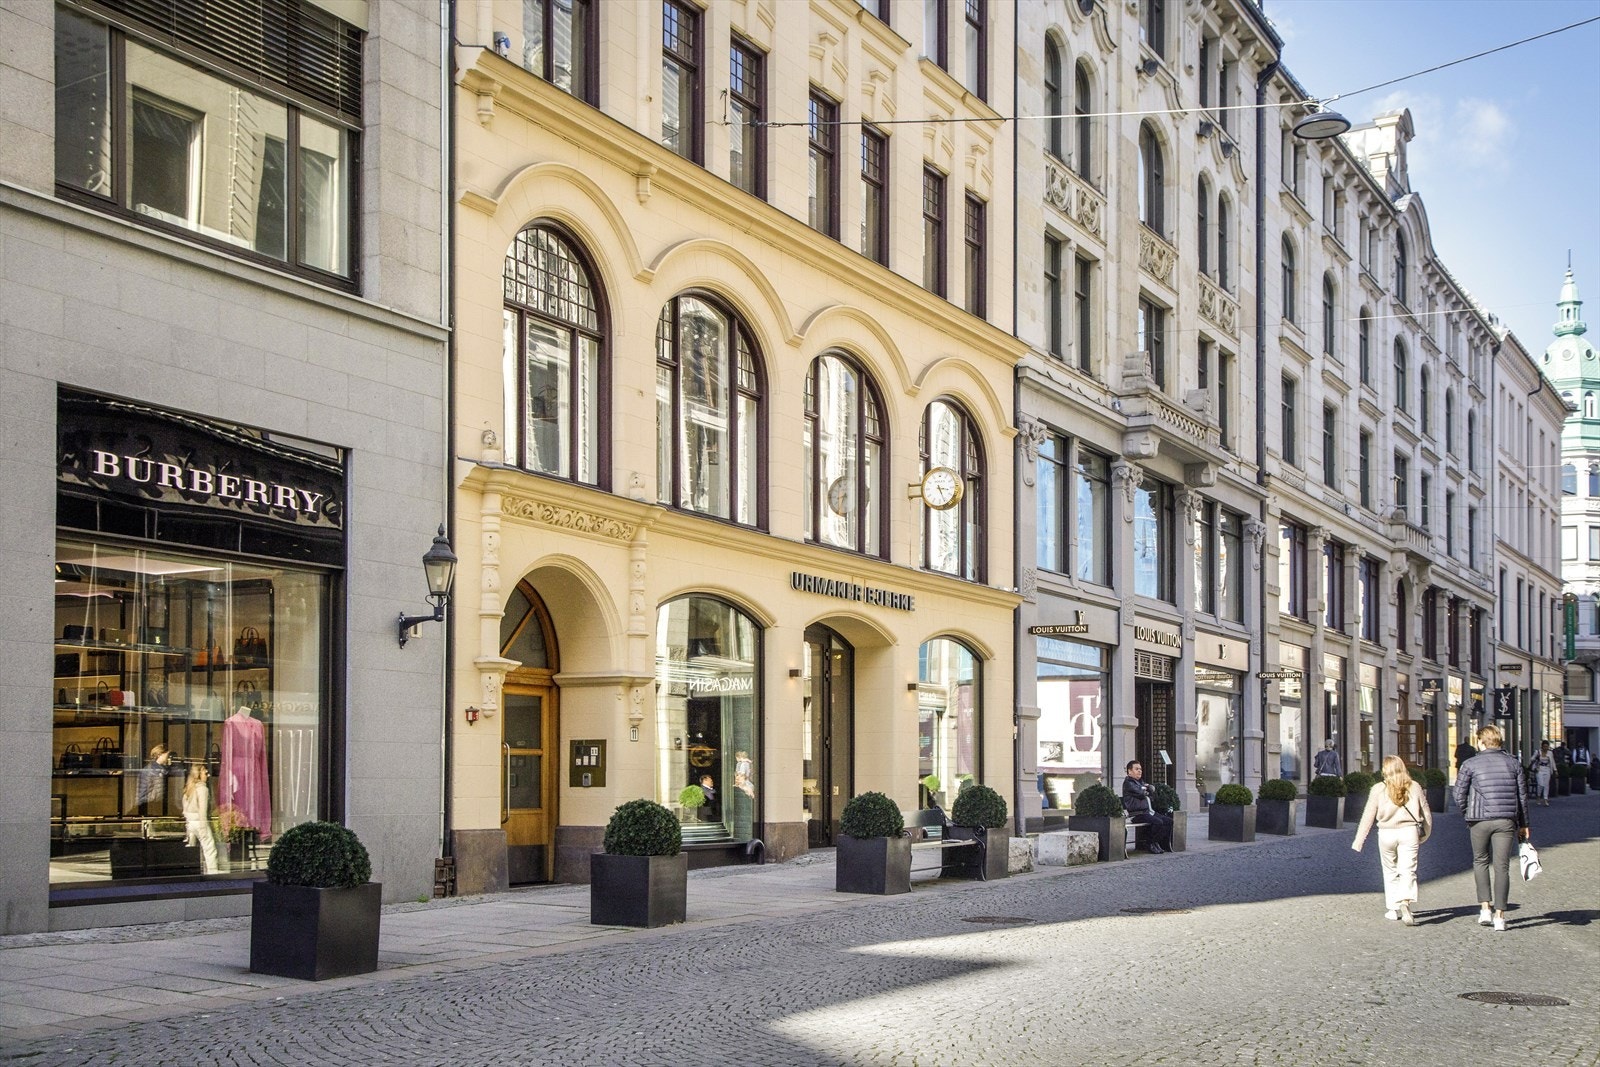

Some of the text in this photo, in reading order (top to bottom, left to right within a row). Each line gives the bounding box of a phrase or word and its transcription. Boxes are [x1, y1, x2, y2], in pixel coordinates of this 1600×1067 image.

[93, 450, 323, 513] BURBERRY
[789, 571, 916, 612] URMAKER BJERKE
[1032, 625, 1087, 634] LOUIS VUITTON
[1137, 626, 1182, 648] LOUIS VUITTON
